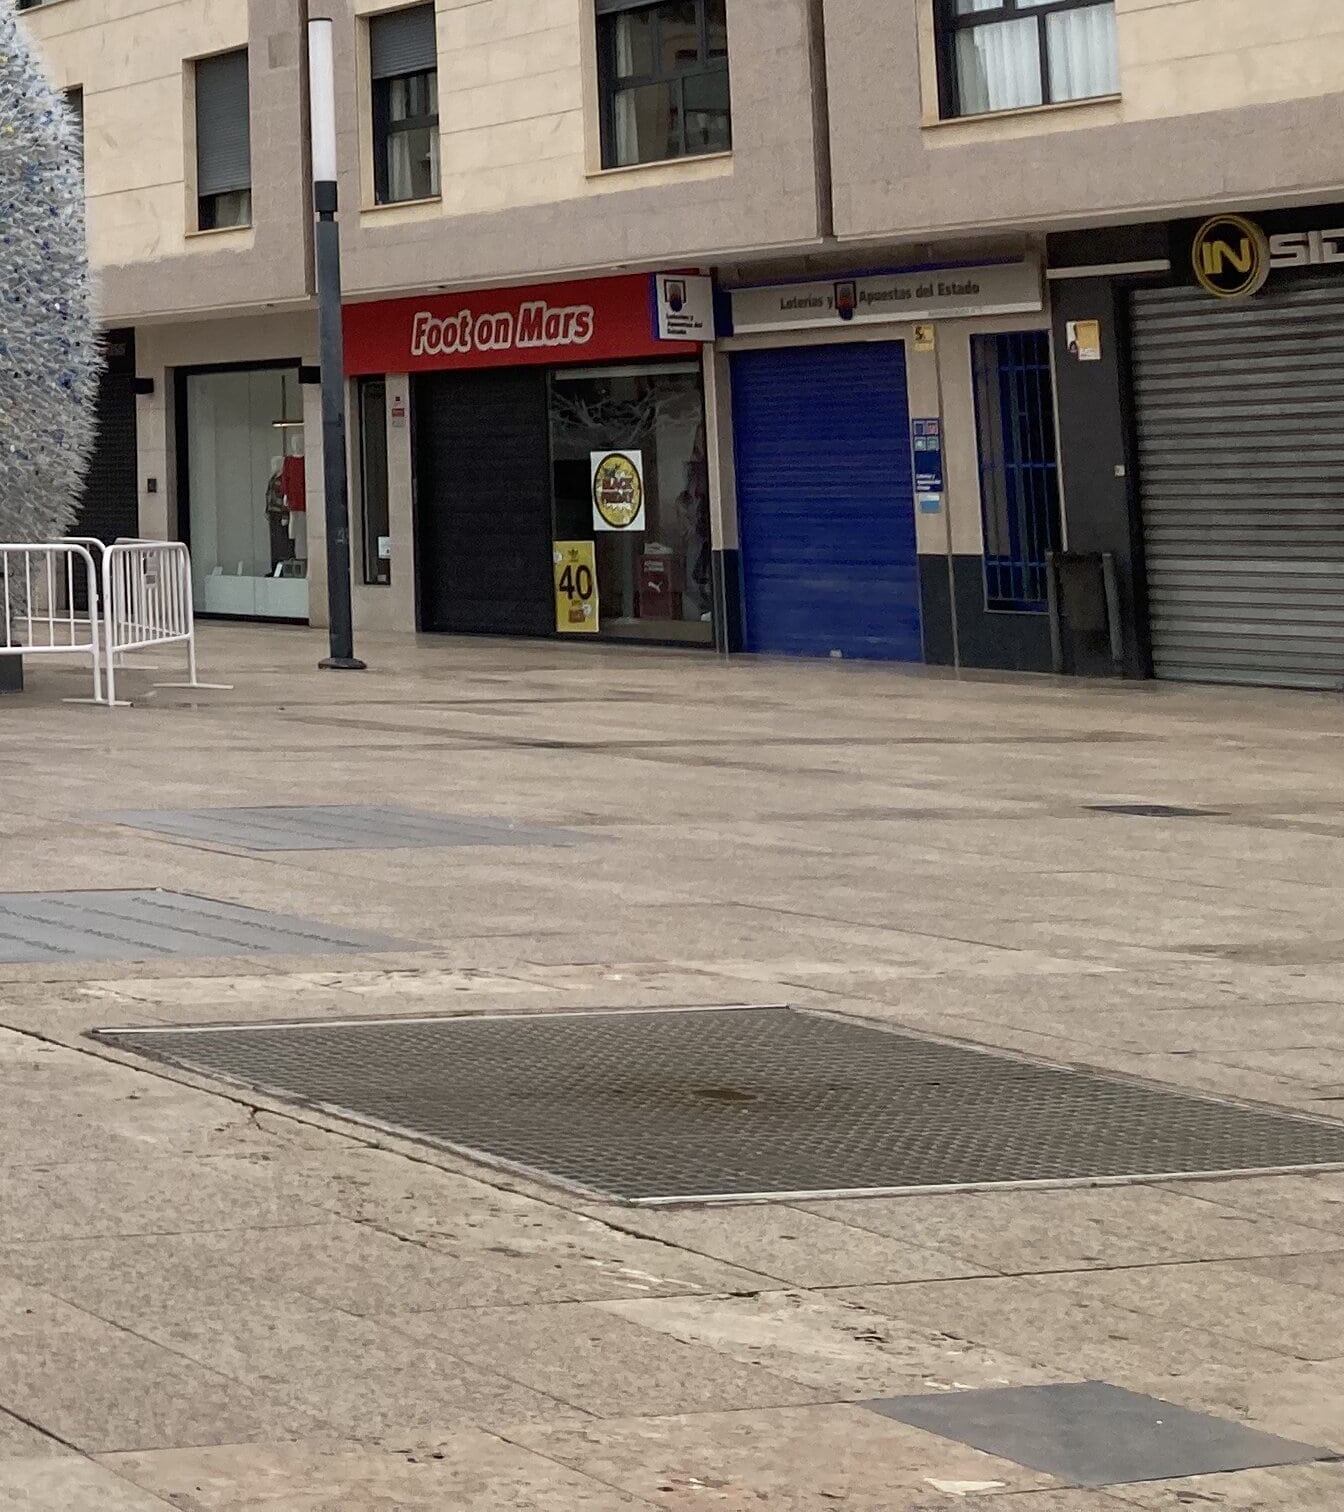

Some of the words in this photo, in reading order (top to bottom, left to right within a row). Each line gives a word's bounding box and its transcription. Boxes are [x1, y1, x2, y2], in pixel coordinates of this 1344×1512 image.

[915, 283, 934, 298] del
[937, 280, 981, 296] Estado
[411, 308, 473, 356] Foot
[473, 312, 512, 351] on
[515, 300, 594, 348] Mars
[558, 564, 593, 601] 40
